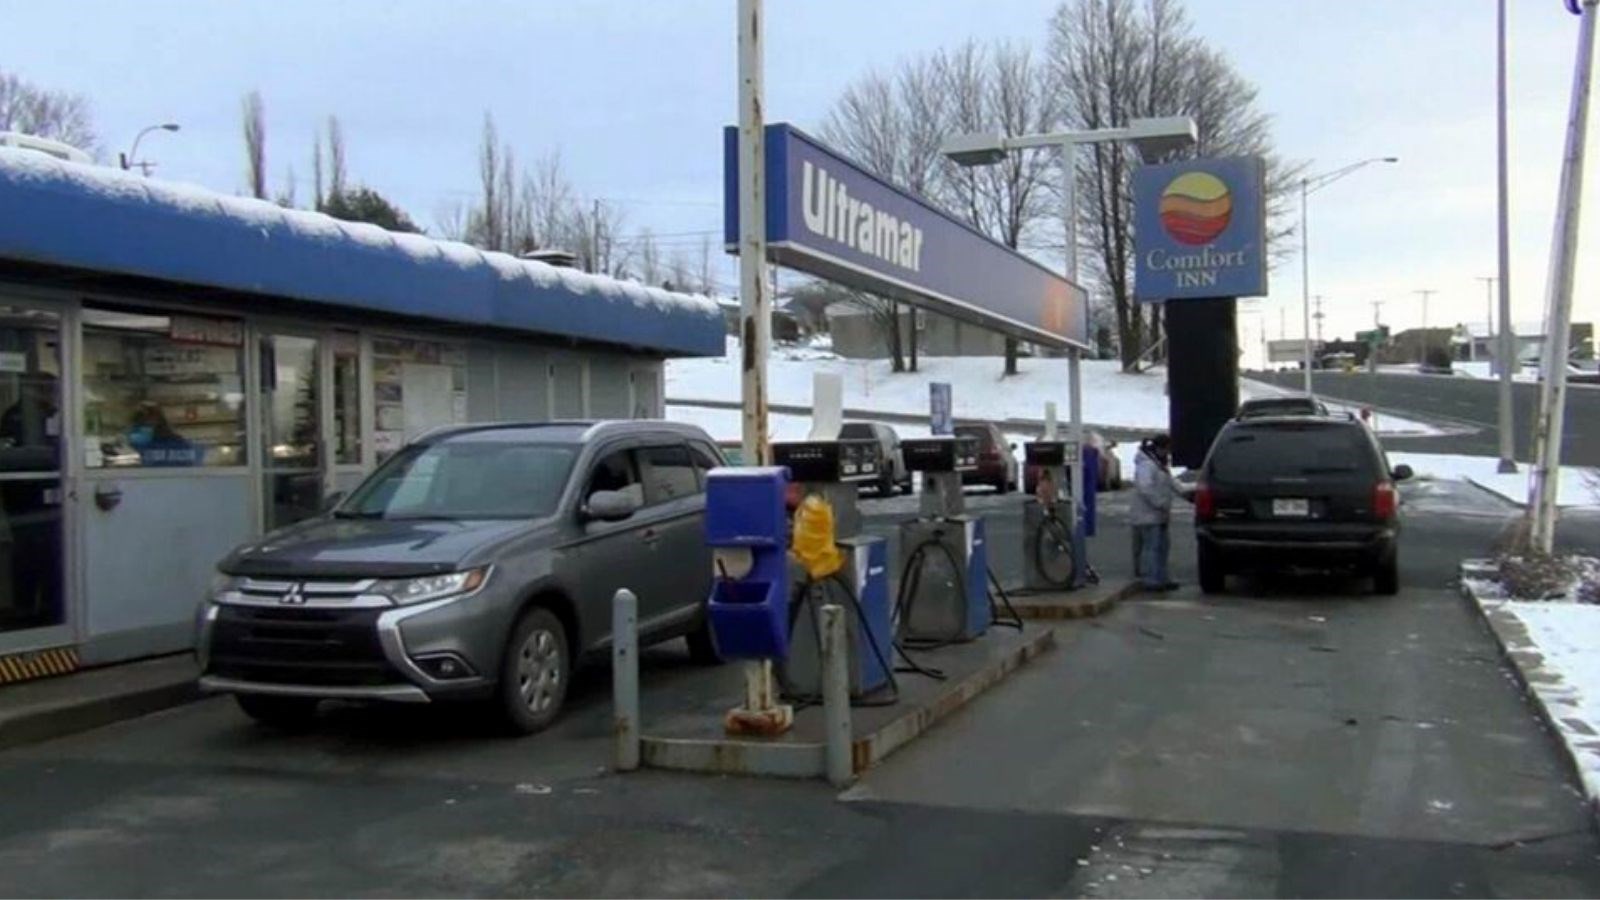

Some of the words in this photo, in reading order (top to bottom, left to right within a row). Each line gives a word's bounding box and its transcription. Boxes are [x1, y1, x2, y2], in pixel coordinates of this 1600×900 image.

[803, 160, 923, 271] Ultramar
[1146, 244, 1245, 271] Comfort
[1176, 271, 1217, 288] INN
